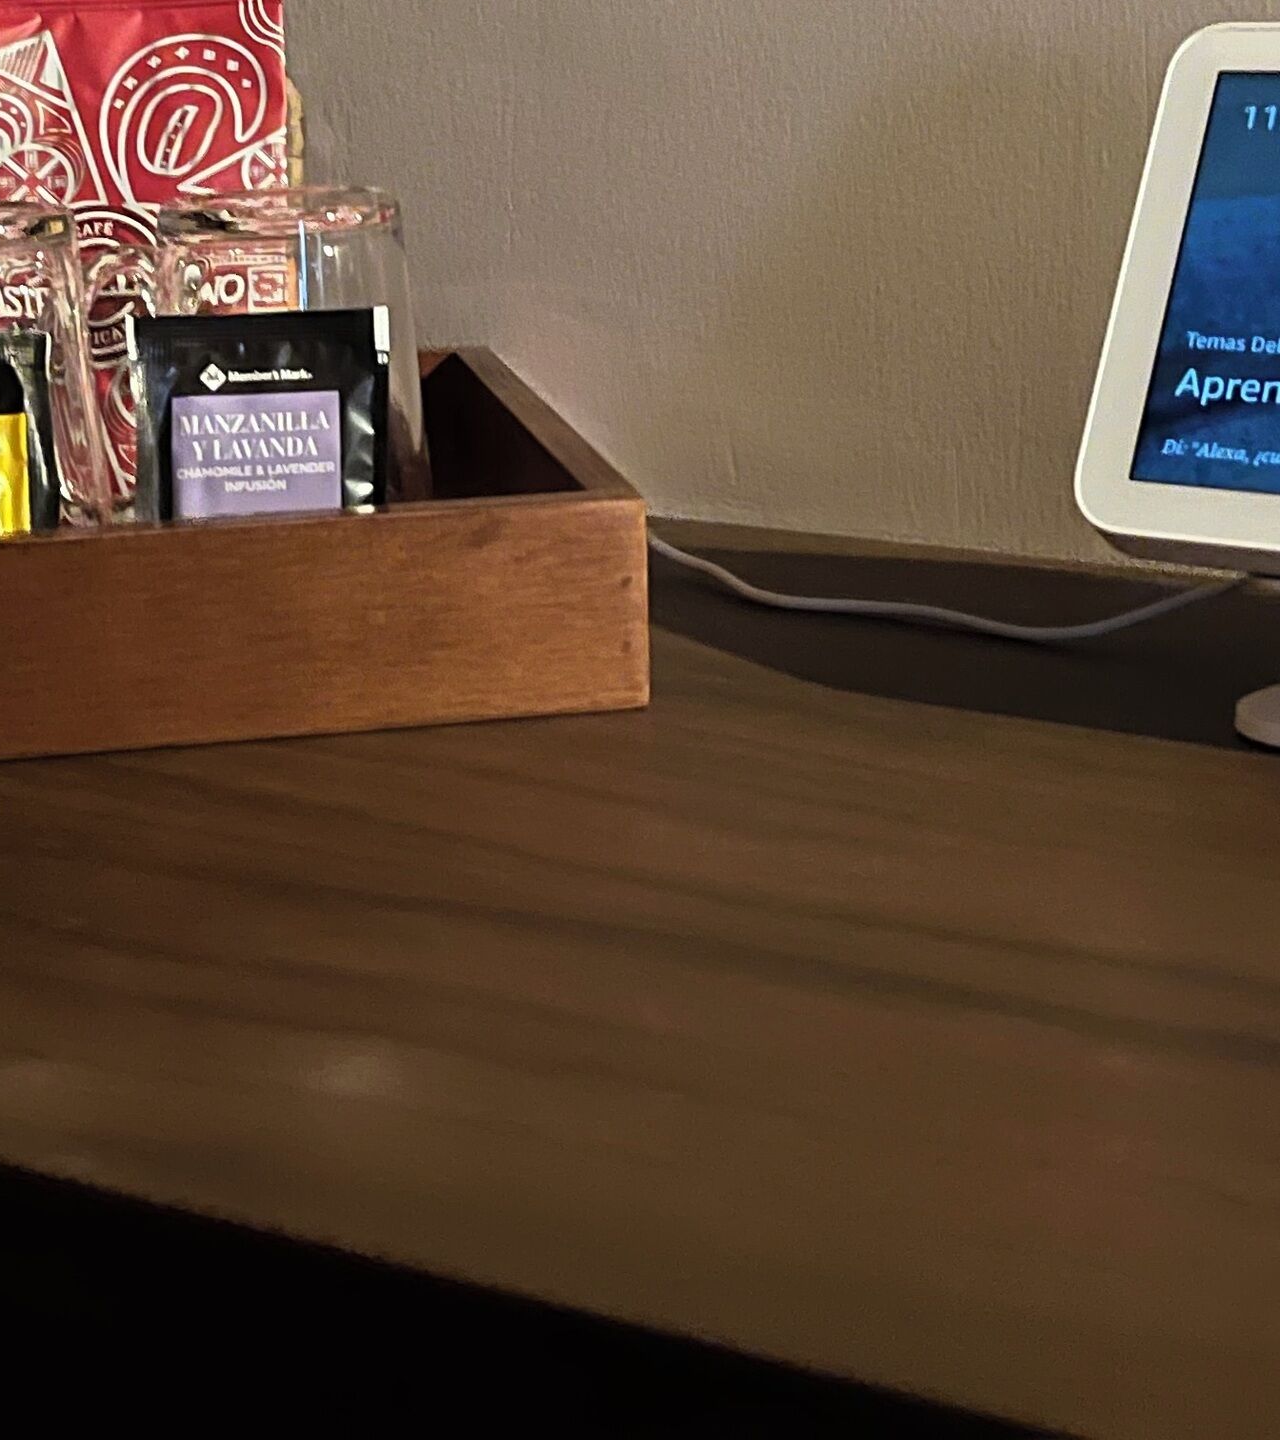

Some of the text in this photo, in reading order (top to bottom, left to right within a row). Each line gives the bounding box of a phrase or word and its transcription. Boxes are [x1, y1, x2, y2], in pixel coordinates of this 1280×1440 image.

[1186, 330, 1246, 353] Temas
[180, 410, 330, 436] MANZANILLA
[192, 435, 319, 461] Y LAVANDA
[268, 461, 336, 476] LAVENDER
